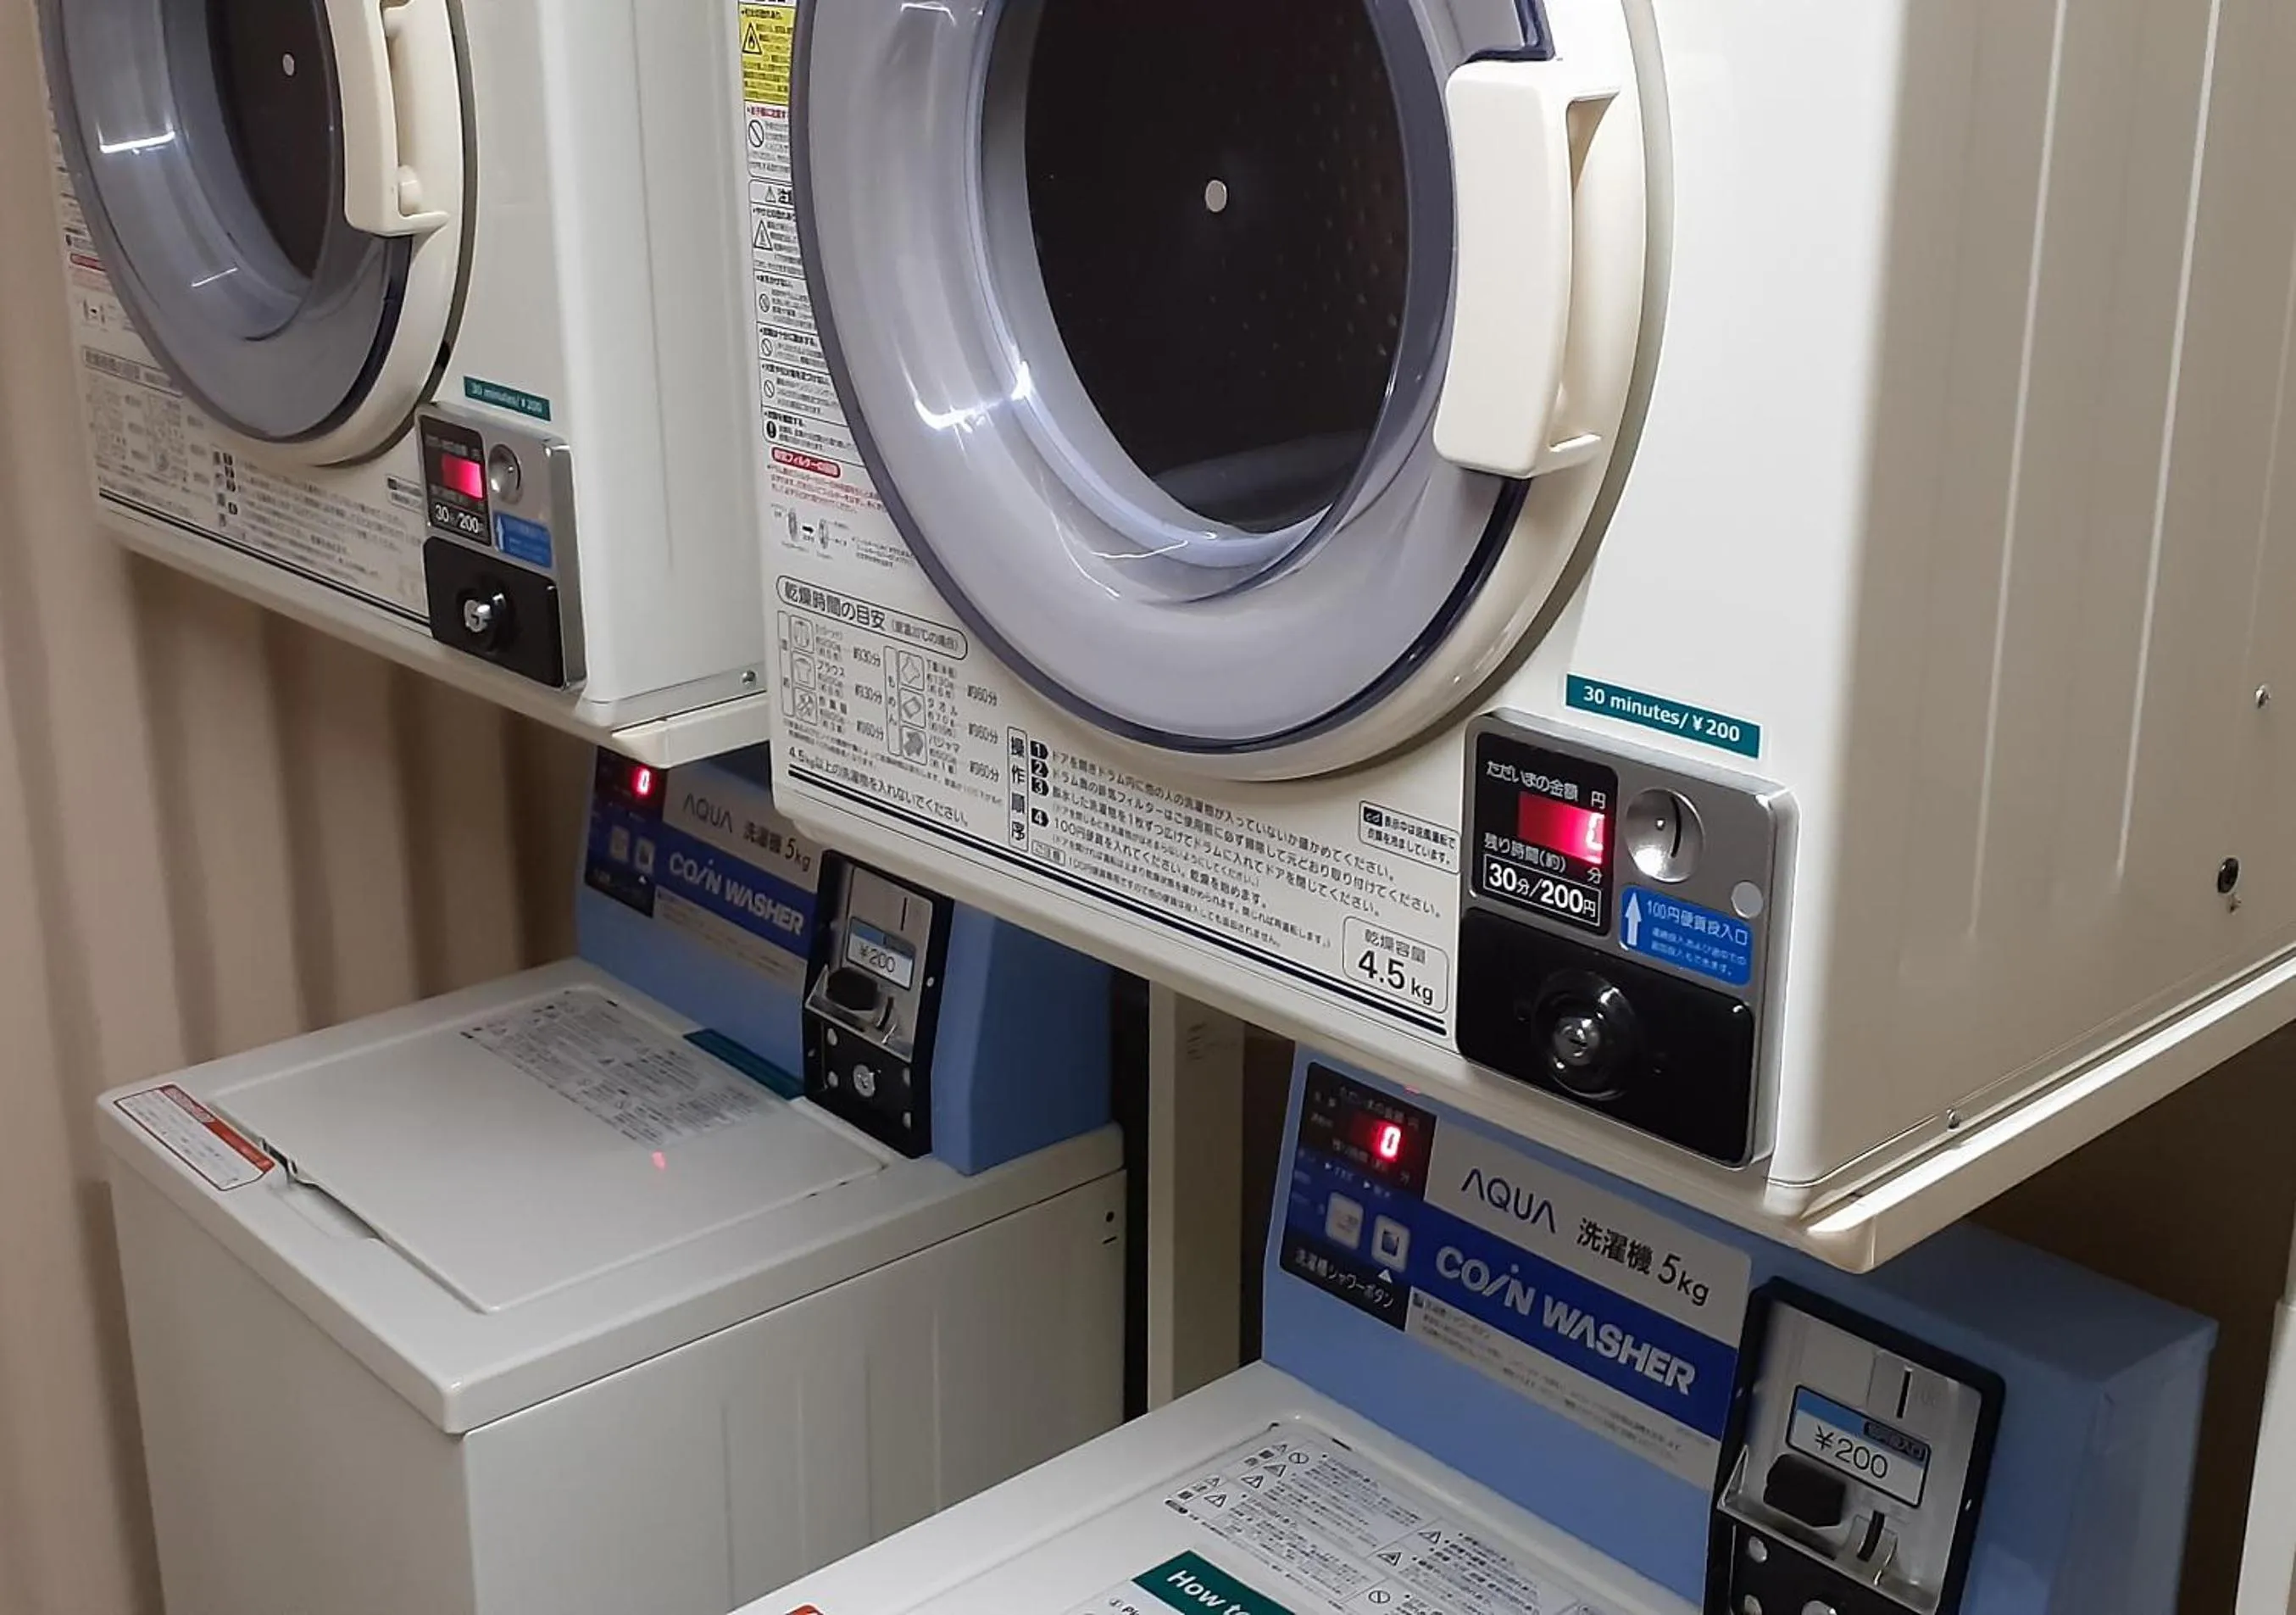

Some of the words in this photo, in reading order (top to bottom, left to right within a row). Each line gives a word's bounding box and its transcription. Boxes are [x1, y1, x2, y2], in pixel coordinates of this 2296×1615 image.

[785, 581, 886, 631] 乾燥時間の目安
[1583, 685, 1605, 704] 30
[638, 767, 651, 795] 0
[1486, 761, 1579, 801] ただいまの金額
[1591, 790, 1606, 809] 円
[684, 793, 733, 833] AQUA
[785, 838, 811, 873] 5kg
[1489, 863, 1596, 917] 30分/200円
[1587, 867, 1603, 884] 分
[725, 878, 804, 936] WASHER
[1647, 899, 1748, 946] 100円硬貨投入口
[859, 943, 896, 973] ¥200
[1365, 928, 1426, 964] 乾燥容量
[1380, 1125, 1401, 1158] 0
[1460, 1167, 1557, 1234] AQUA
[1576, 1217, 1654, 1276] 洗濯機
[1658, 1253, 1709, 1306] 5kg
[1543, 1295, 1696, 1395] WASHER
[1814, 1424, 1888, 1479] ¥200
[1166, 1569, 1226, 1607] How
